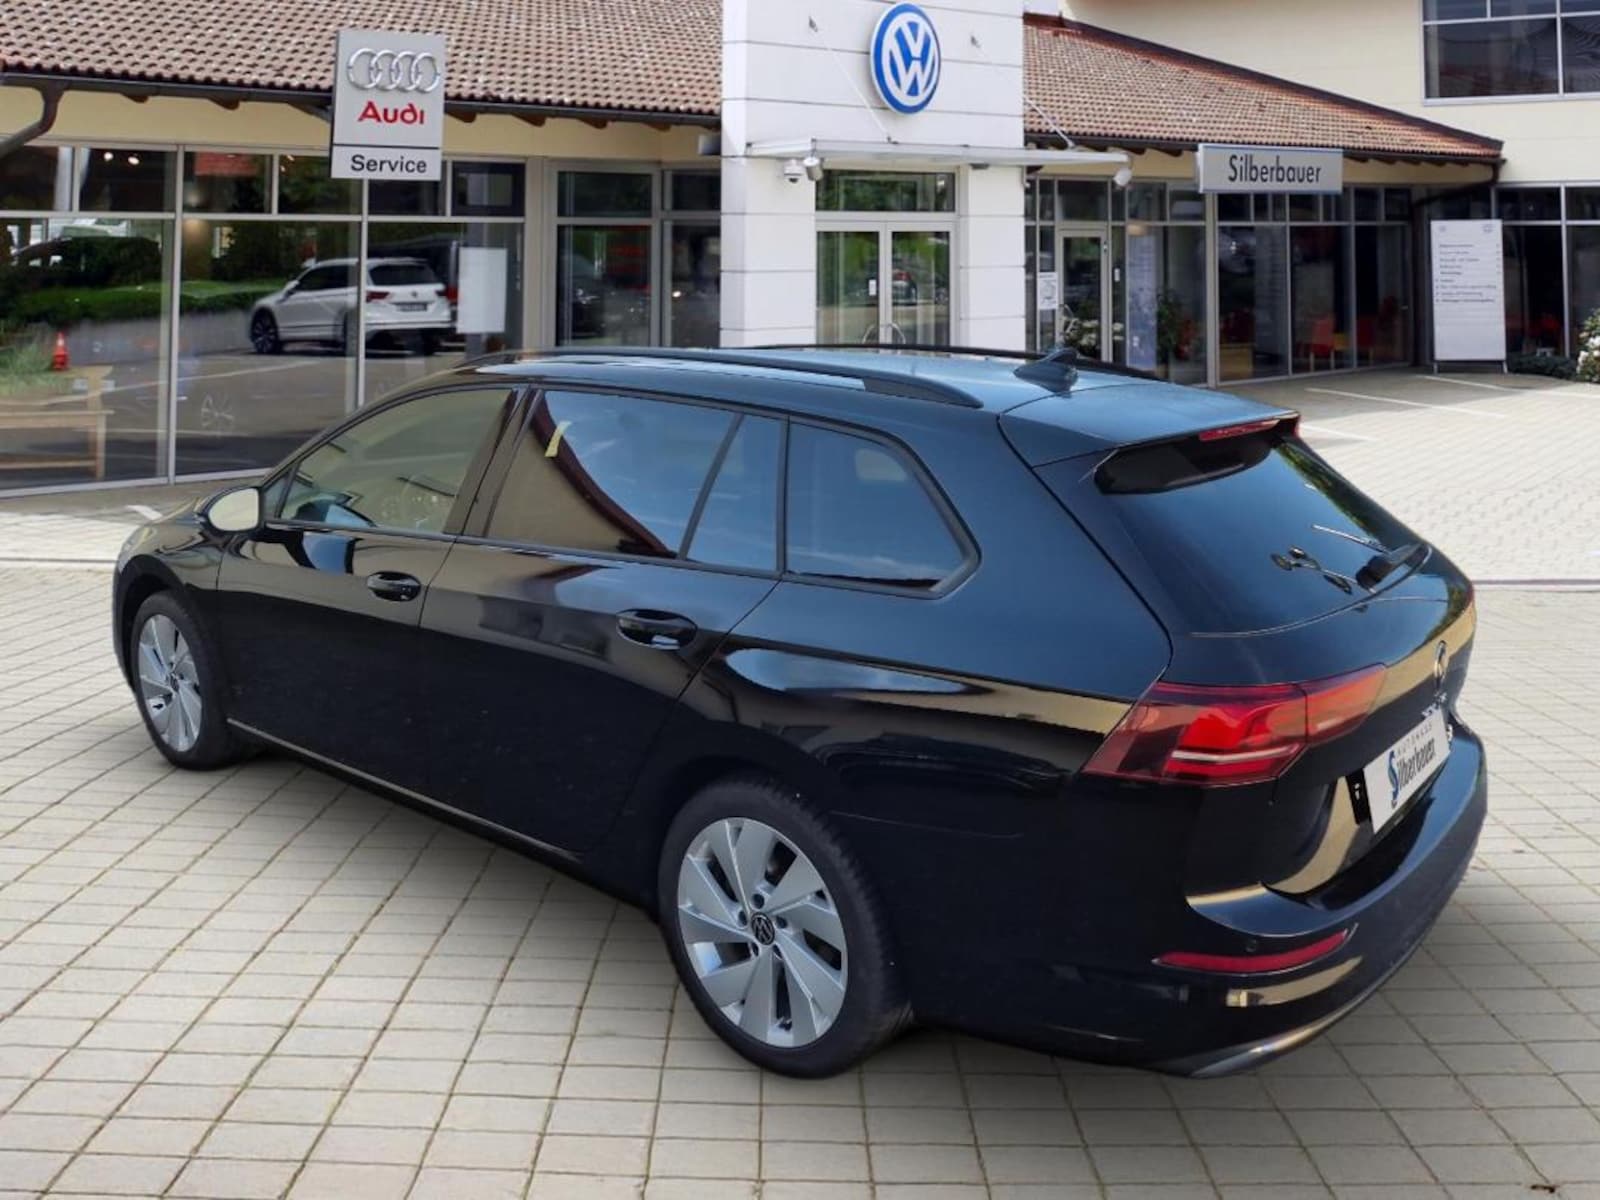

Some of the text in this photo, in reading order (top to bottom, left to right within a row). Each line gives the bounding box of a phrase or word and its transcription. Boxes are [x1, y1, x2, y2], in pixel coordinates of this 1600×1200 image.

[881, 11, 938, 106] VW
[357, 100, 424, 125] Audi
[350, 153, 427, 174] Service
[1228, 153, 1321, 183] Silberbauer
